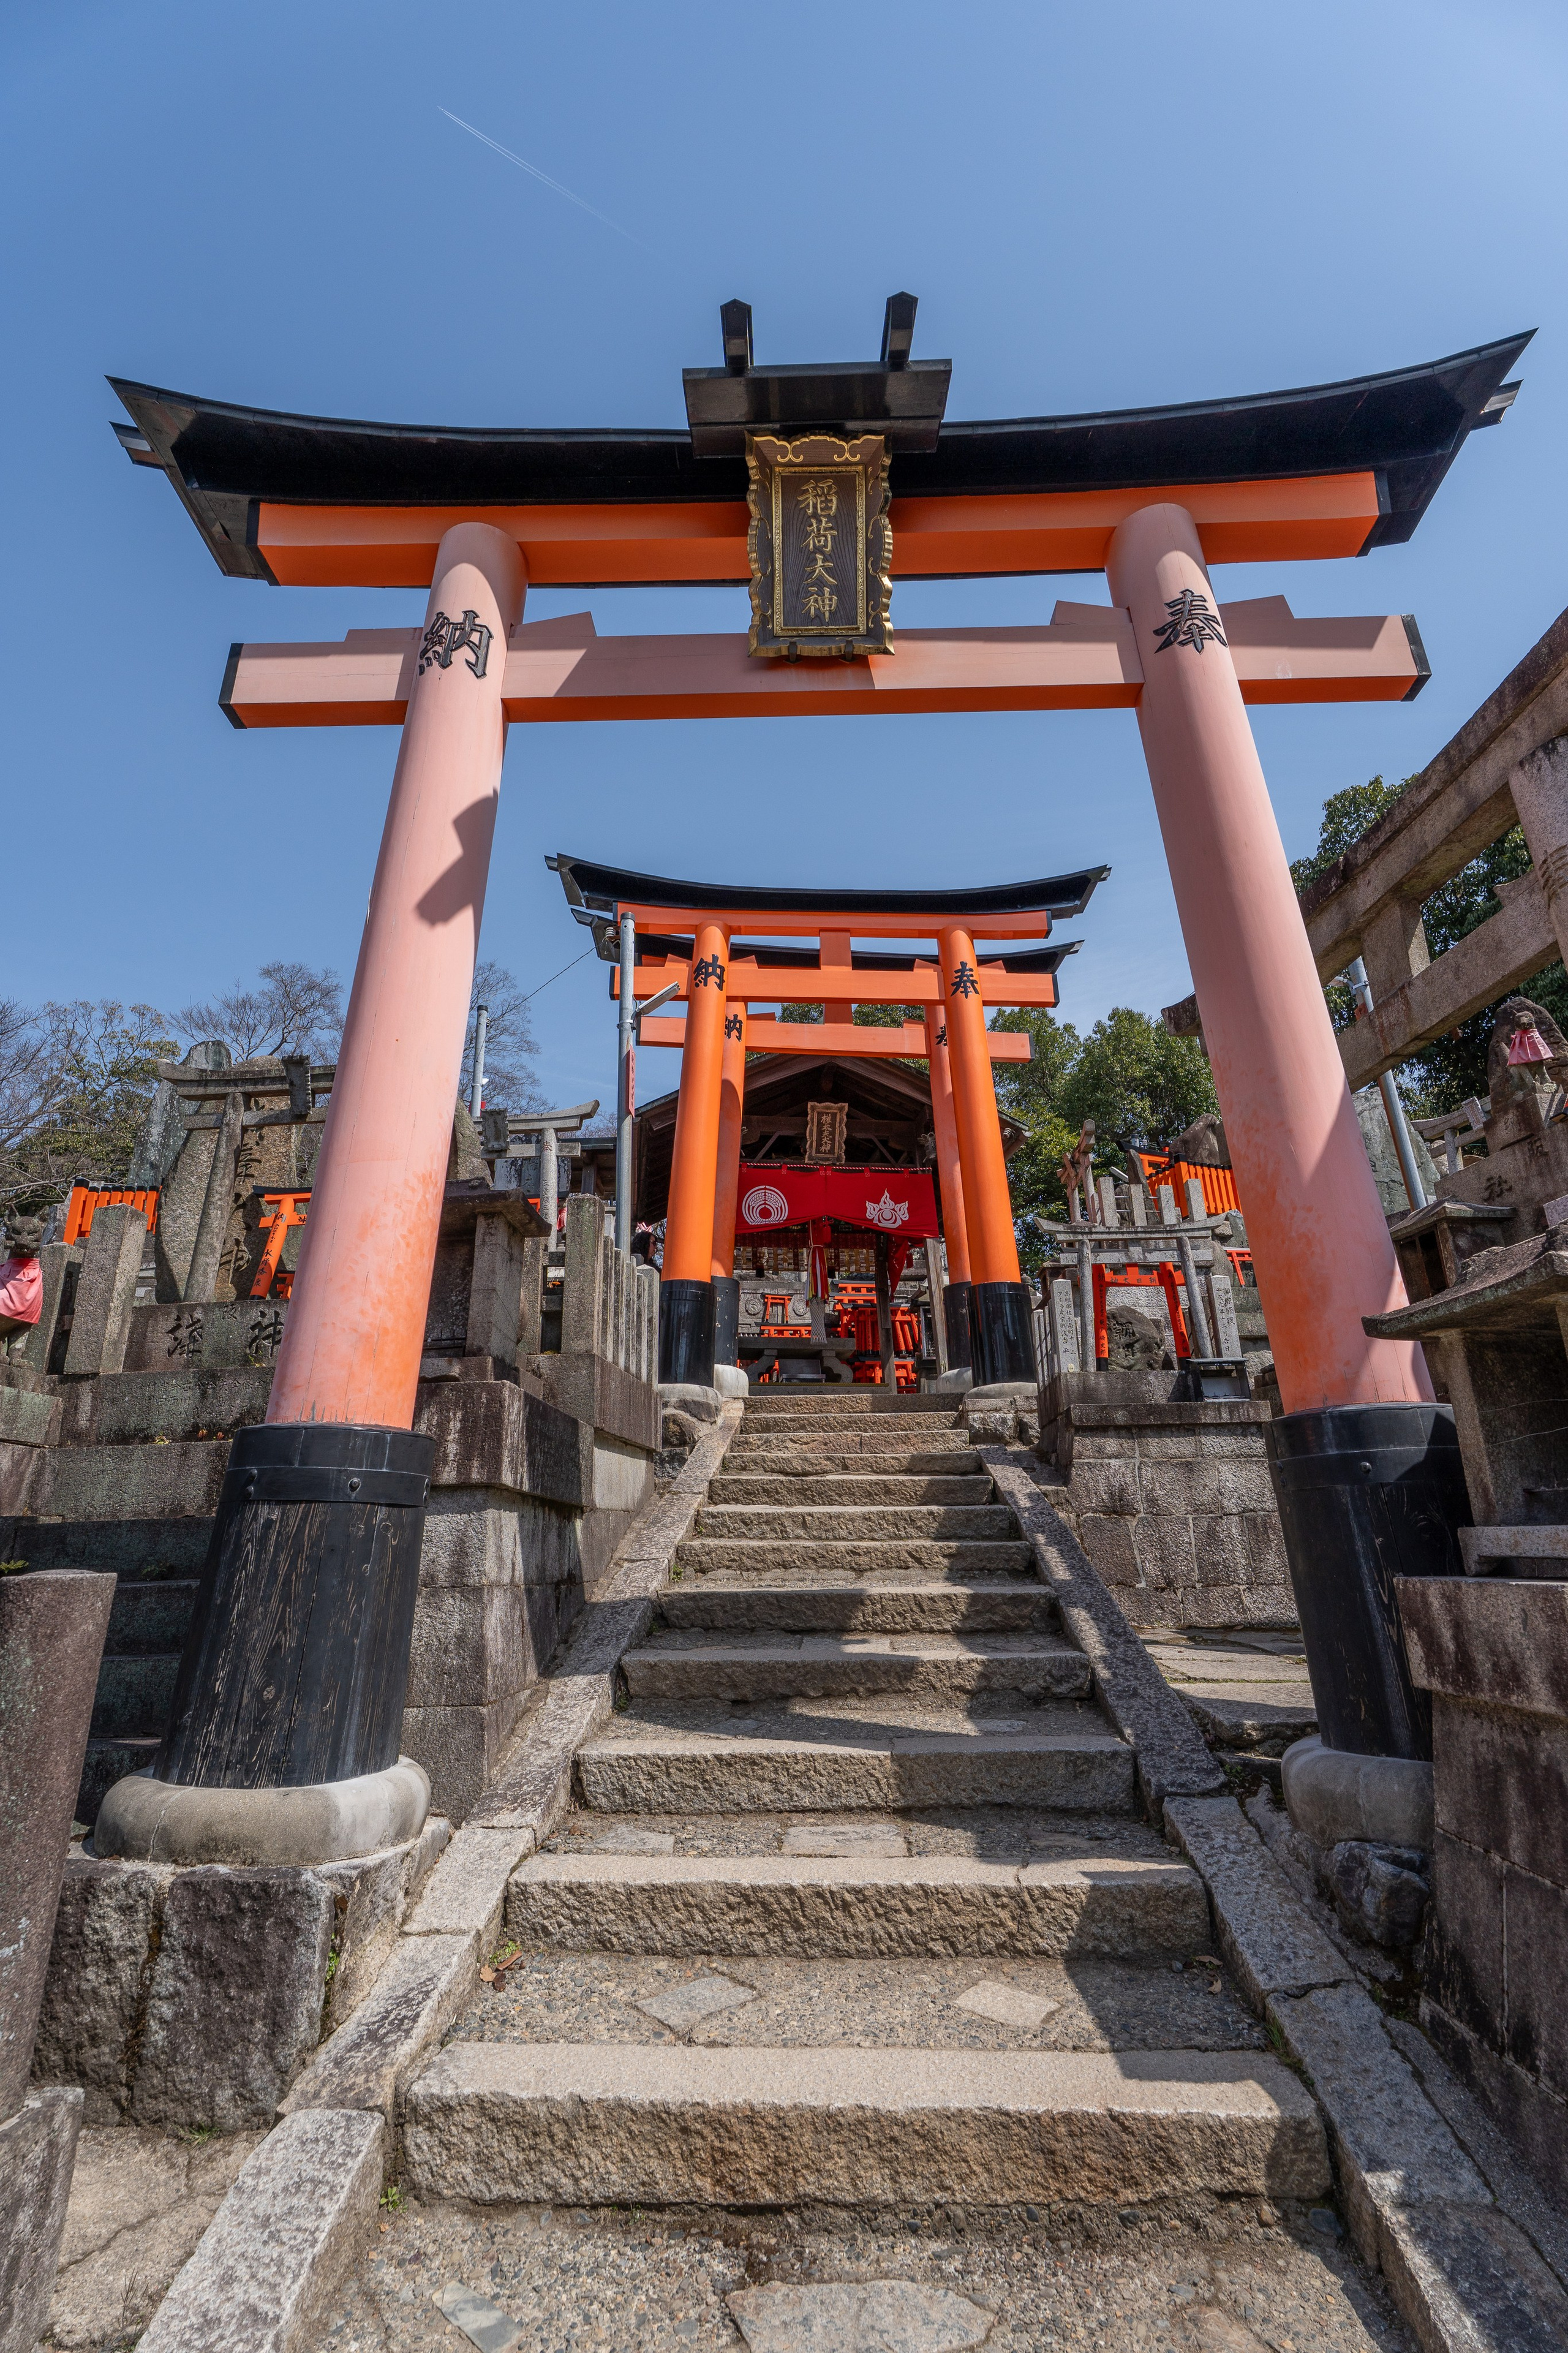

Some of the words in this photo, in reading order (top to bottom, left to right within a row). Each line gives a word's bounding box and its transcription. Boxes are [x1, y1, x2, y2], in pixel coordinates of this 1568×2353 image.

[797, 479, 838, 622] 稲荷大神
[418, 610, 494, 679] 納
[1153, 589, 1228, 654] 奉
[693, 954, 726, 992] 納
[951, 961, 980, 999] 奉
[541, 1140, 552, 1152] 奉
